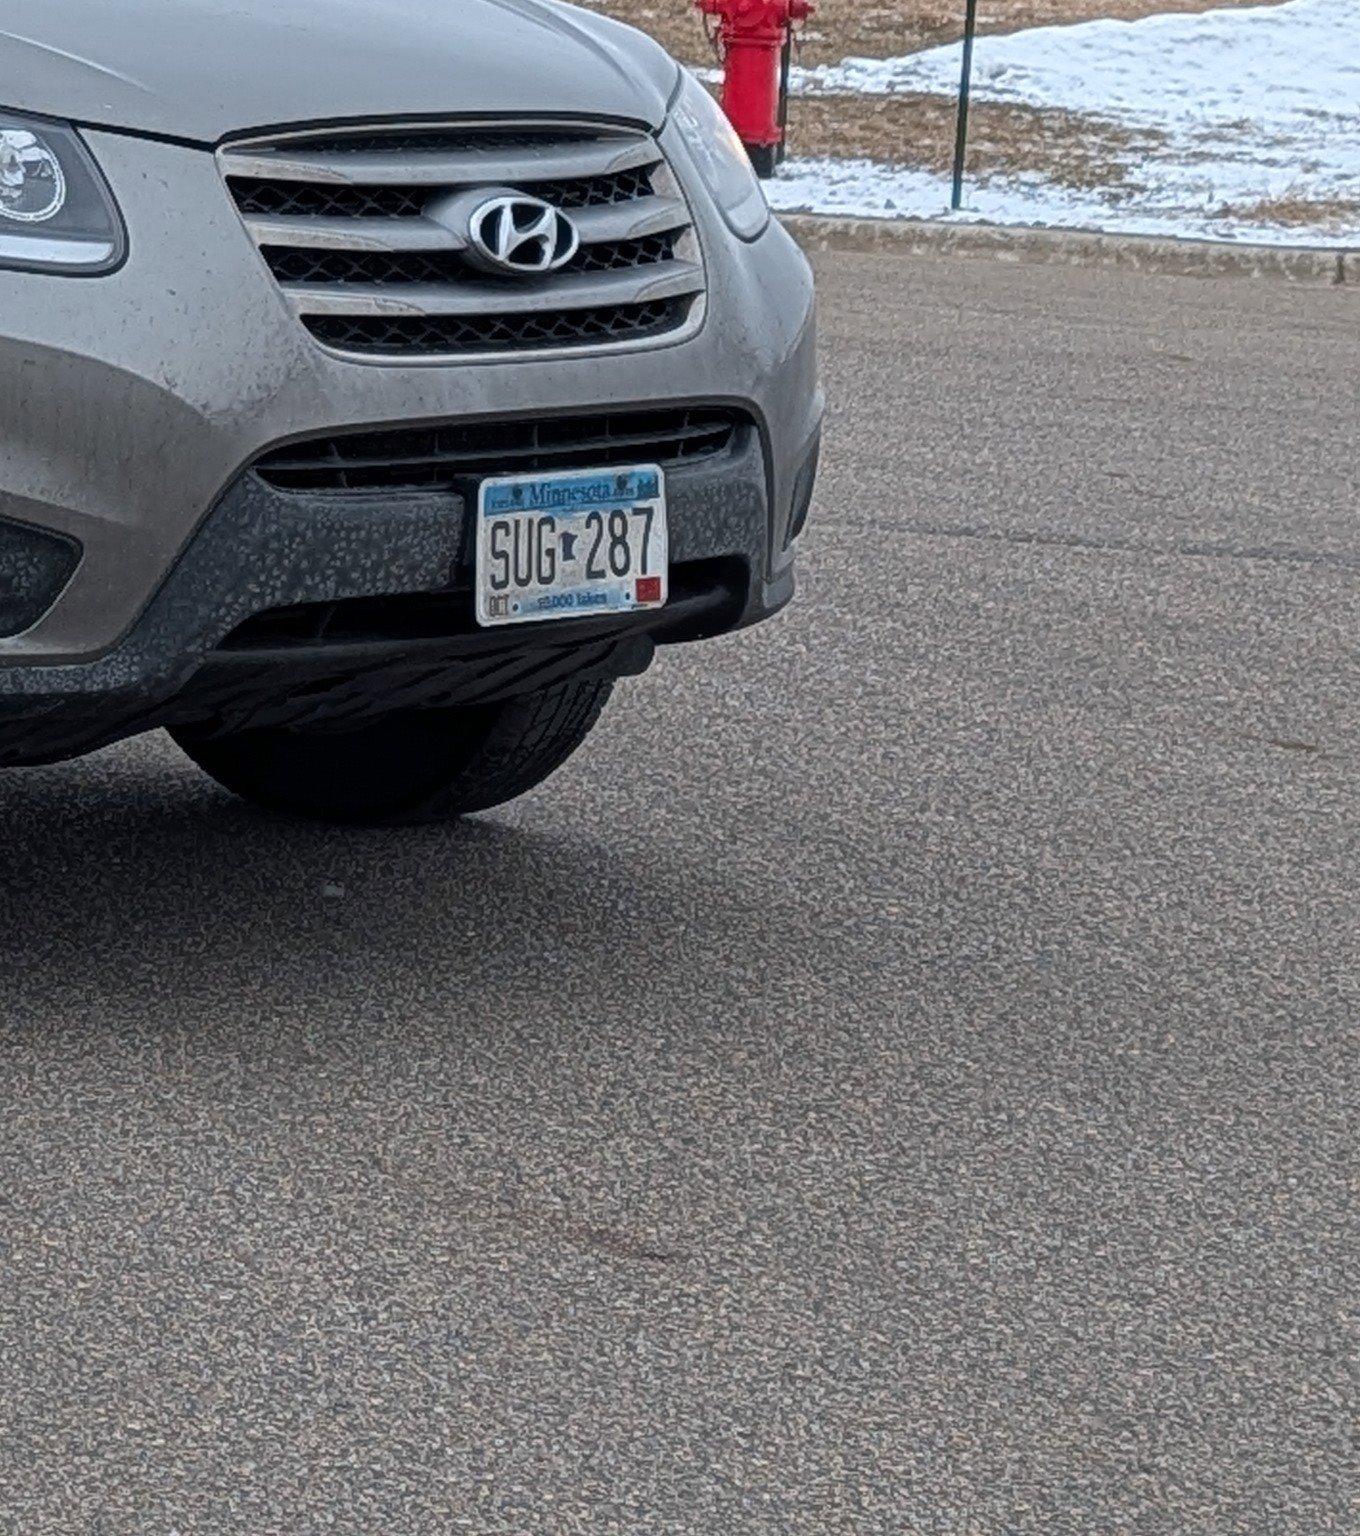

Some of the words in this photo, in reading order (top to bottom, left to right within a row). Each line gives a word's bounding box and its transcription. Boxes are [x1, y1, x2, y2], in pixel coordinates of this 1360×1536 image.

[530, 482, 612, 506] Minnesota
[490, 517, 557, 590] SUG
[585, 507, 654, 579] 287
